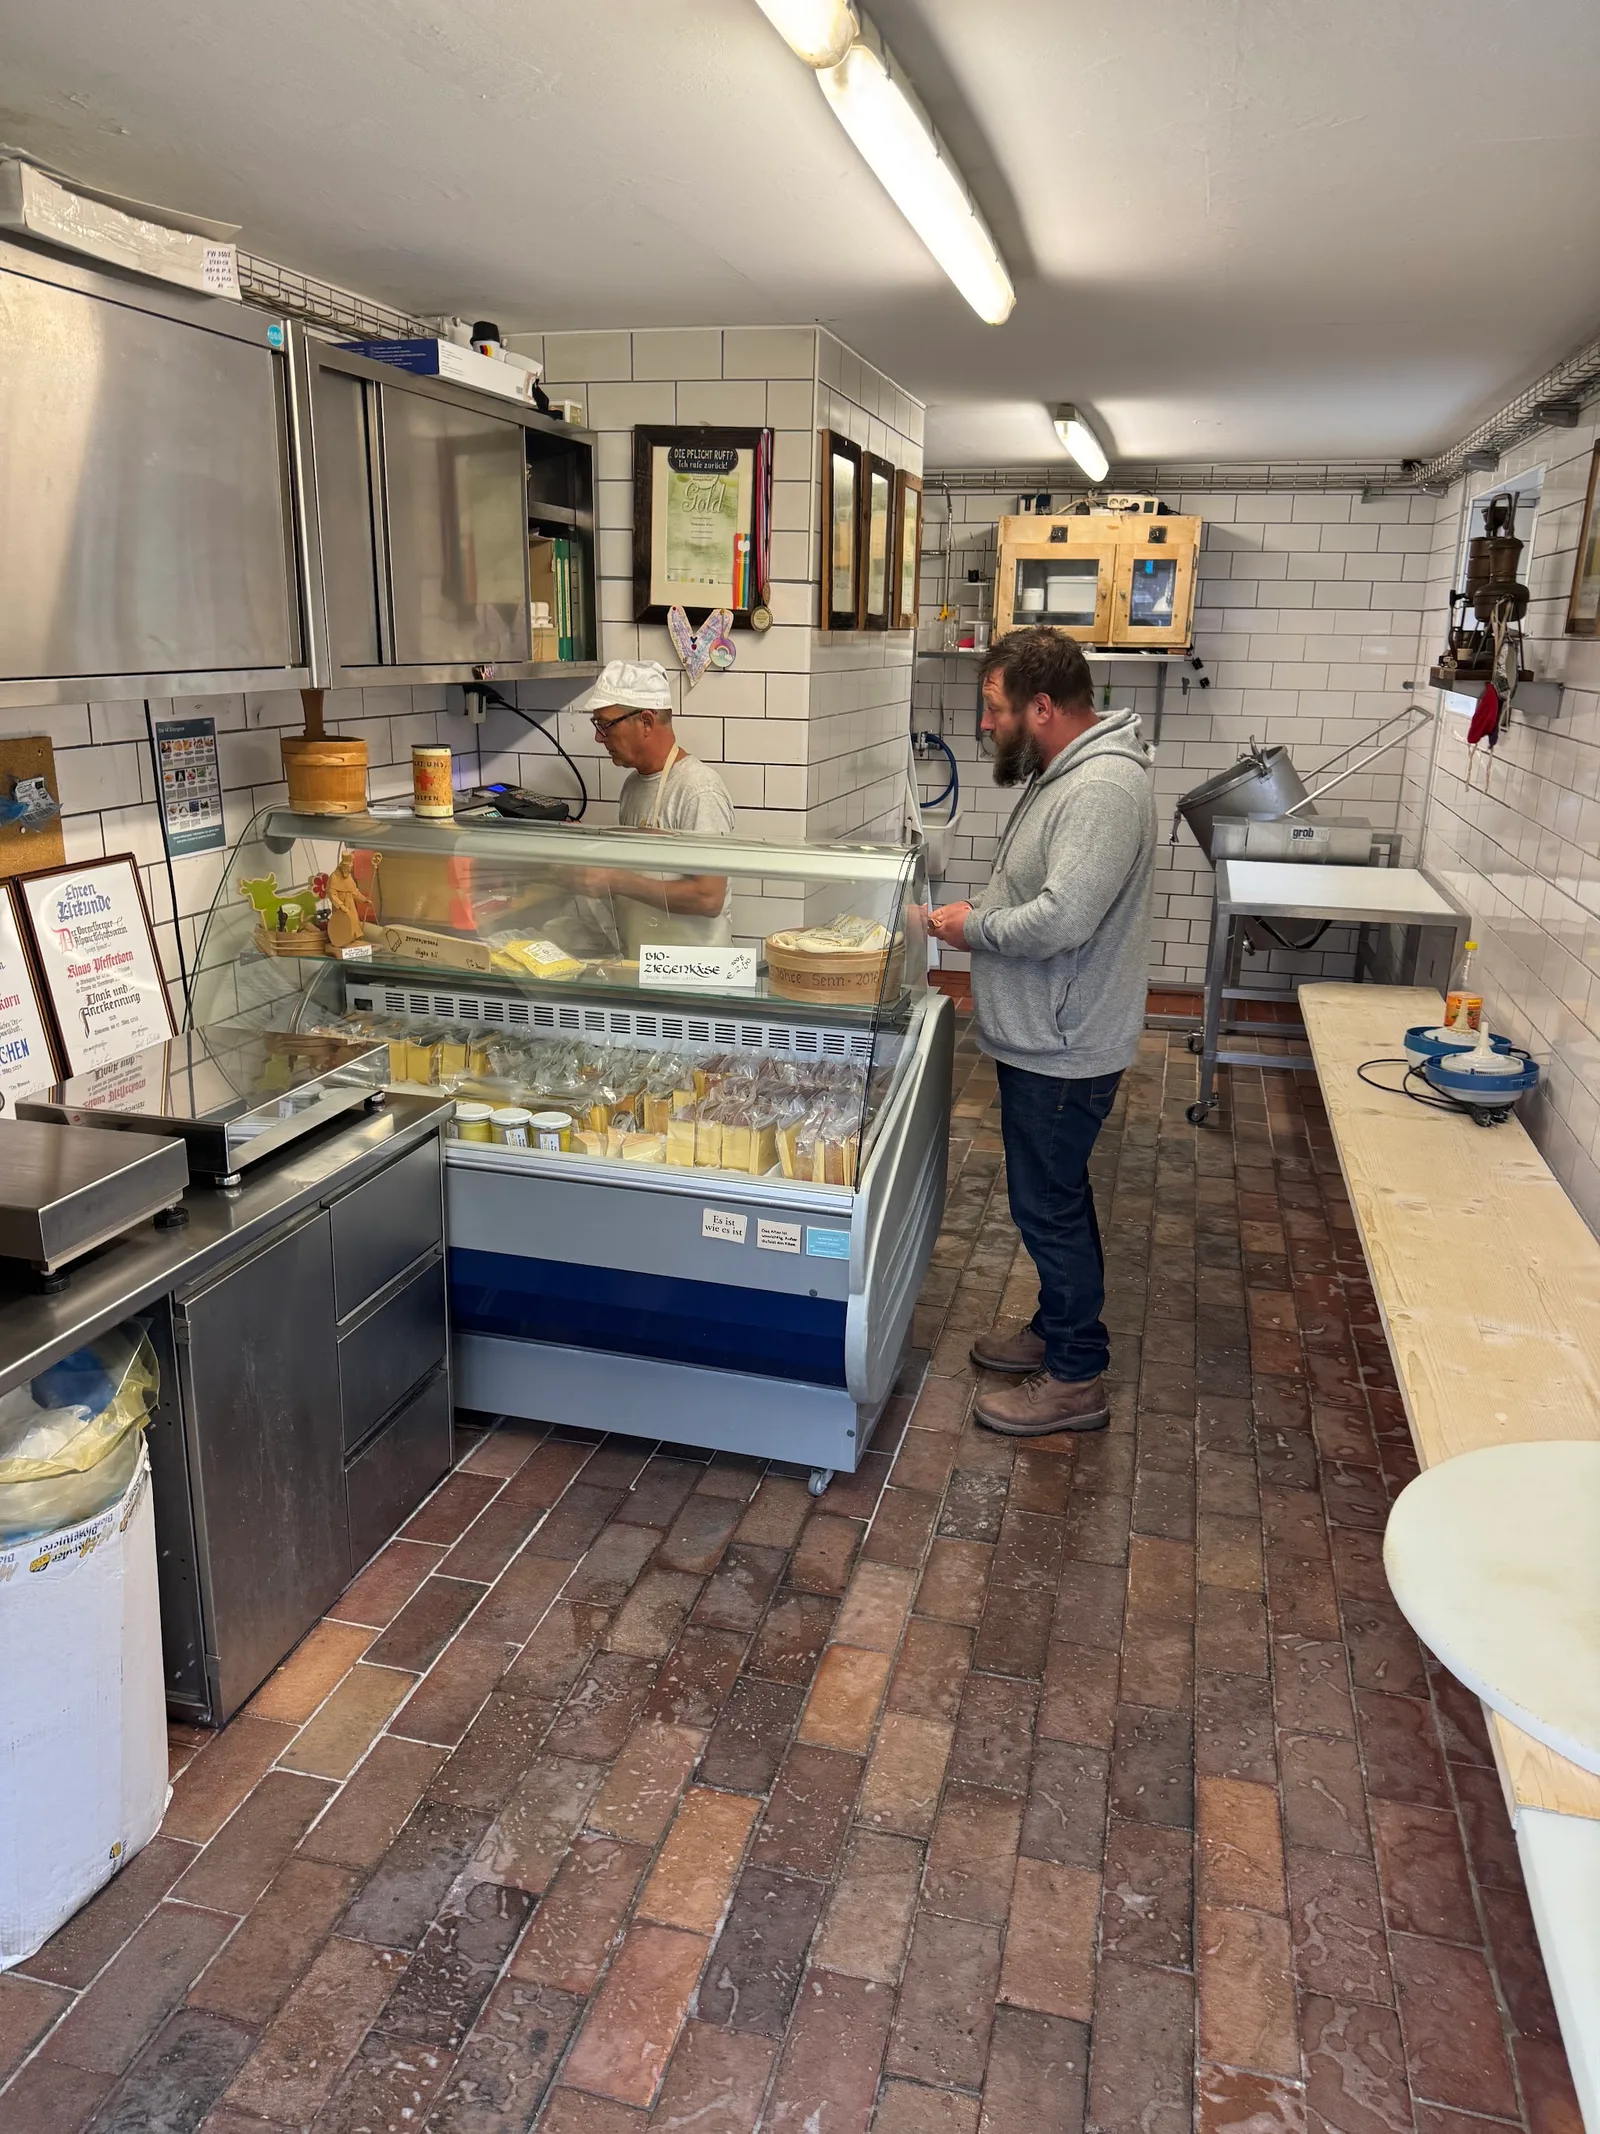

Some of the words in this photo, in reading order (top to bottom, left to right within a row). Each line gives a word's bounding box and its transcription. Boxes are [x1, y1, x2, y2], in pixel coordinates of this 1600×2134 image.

[674, 448, 686, 459] DIE
[687, 449, 713, 460] PFLICHT
[714, 450, 734, 461] RUFT?
[678, 459, 689, 468] Ich
[689, 461, 703, 469] rufe
[703, 462, 728, 470] zurück!
[682, 474, 727, 514] Gold
[1292, 827, 1314, 840] grob
[65, 884, 97, 901] Ehren
[56, 895, 112, 923] Urkunde
[67, 962, 92, 979] Klaus
[92, 950, 135, 973] Pfefferkorn
[812, 972, 845, 987] Senn
[86, 992, 112, 1007] Dank
[113, 983, 129, 998] und
[78, 992, 142, 1039] Anerkennung
[713, 1215, 723, 1225] Es
[725, 1216, 735, 1227] ist
[704, 1223, 720, 1233] wie
[721, 1227, 730, 1235] es
[732, 1226, 743, 1237] ist
